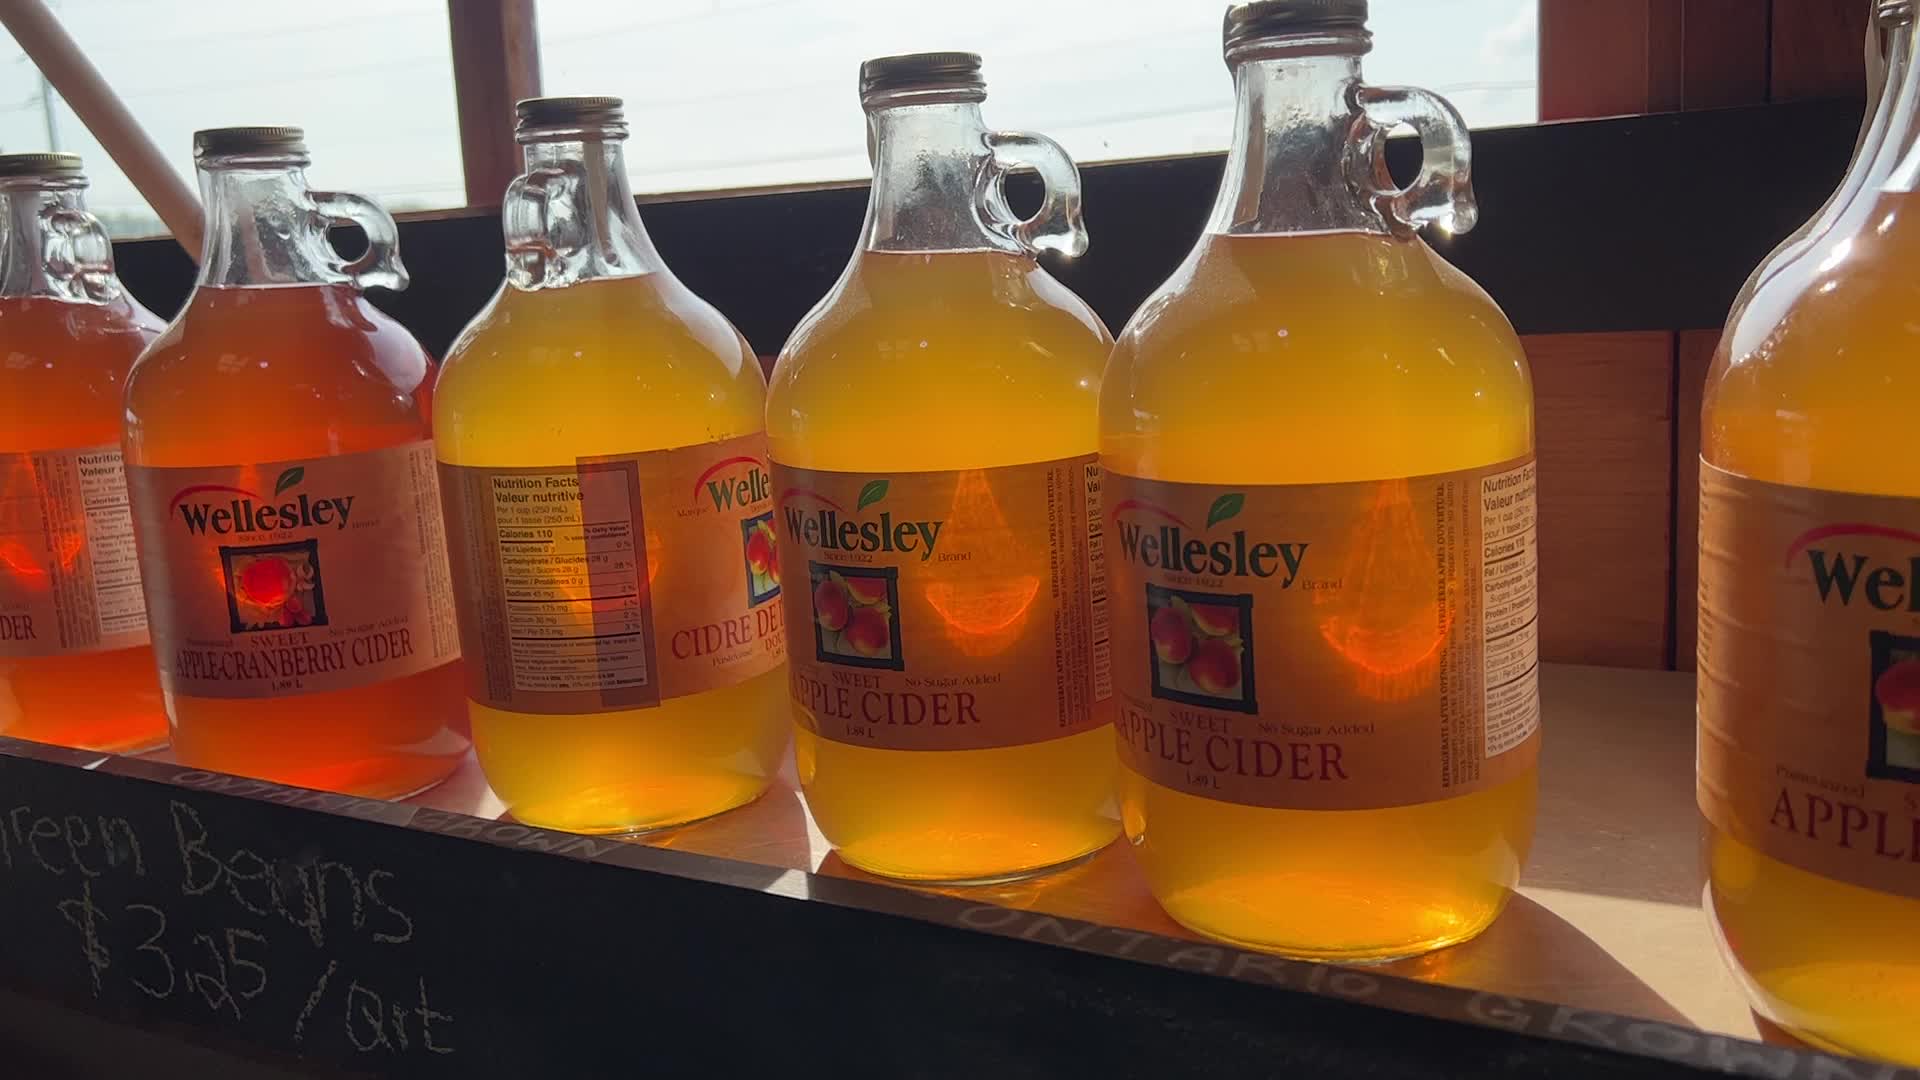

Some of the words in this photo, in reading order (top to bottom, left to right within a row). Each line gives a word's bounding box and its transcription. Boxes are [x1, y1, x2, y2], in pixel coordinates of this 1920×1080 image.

[80, 465, 116, 477] Valeur
[493, 478, 542, 490] Nutrition
[545, 477, 580, 488] Facts
[706, 467, 768, 513] Welle
[1086, 480, 1102, 494] Val
[1484, 473, 1522, 494] Nutrition
[495, 492, 530, 503] Valeur
[533, 491, 585, 503] nutritive
[1484, 495, 1514, 512] Valeur
[179, 494, 356, 536] Wellesley
[499, 529, 534, 539] Calories
[537, 529, 553, 538] 110
[784, 506, 944, 562] Wellesley
[938, 551, 972, 563] Brand
[1117, 519, 1312, 589] Wellesley
[1484, 541, 1514, 558] Calories
[1302, 578, 1344, 590] Brand
[1485, 603, 1508, 619] Protein
[250, 632, 310, 648] SWEET
[671, 614, 753, 660] CIDRE
[756, 606, 777, 640] DE
[176, 639, 347, 681] APPLE-CRANBERRY
[352, 627, 414, 667] CIDER
[831, 670, 881, 689] SWEET
[862, 691, 981, 727] CIDER
[1170, 710, 1231, 734] SWEET
[1327, 720, 1375, 735] Added
[1119, 708, 1193, 767] APPLE
[1205, 734, 1349, 782] CIDER
[0, 803, 147, 879] reen
[413, 811, 620, 859] GROWN
[957, 905, 1379, 999] ONTARIO
